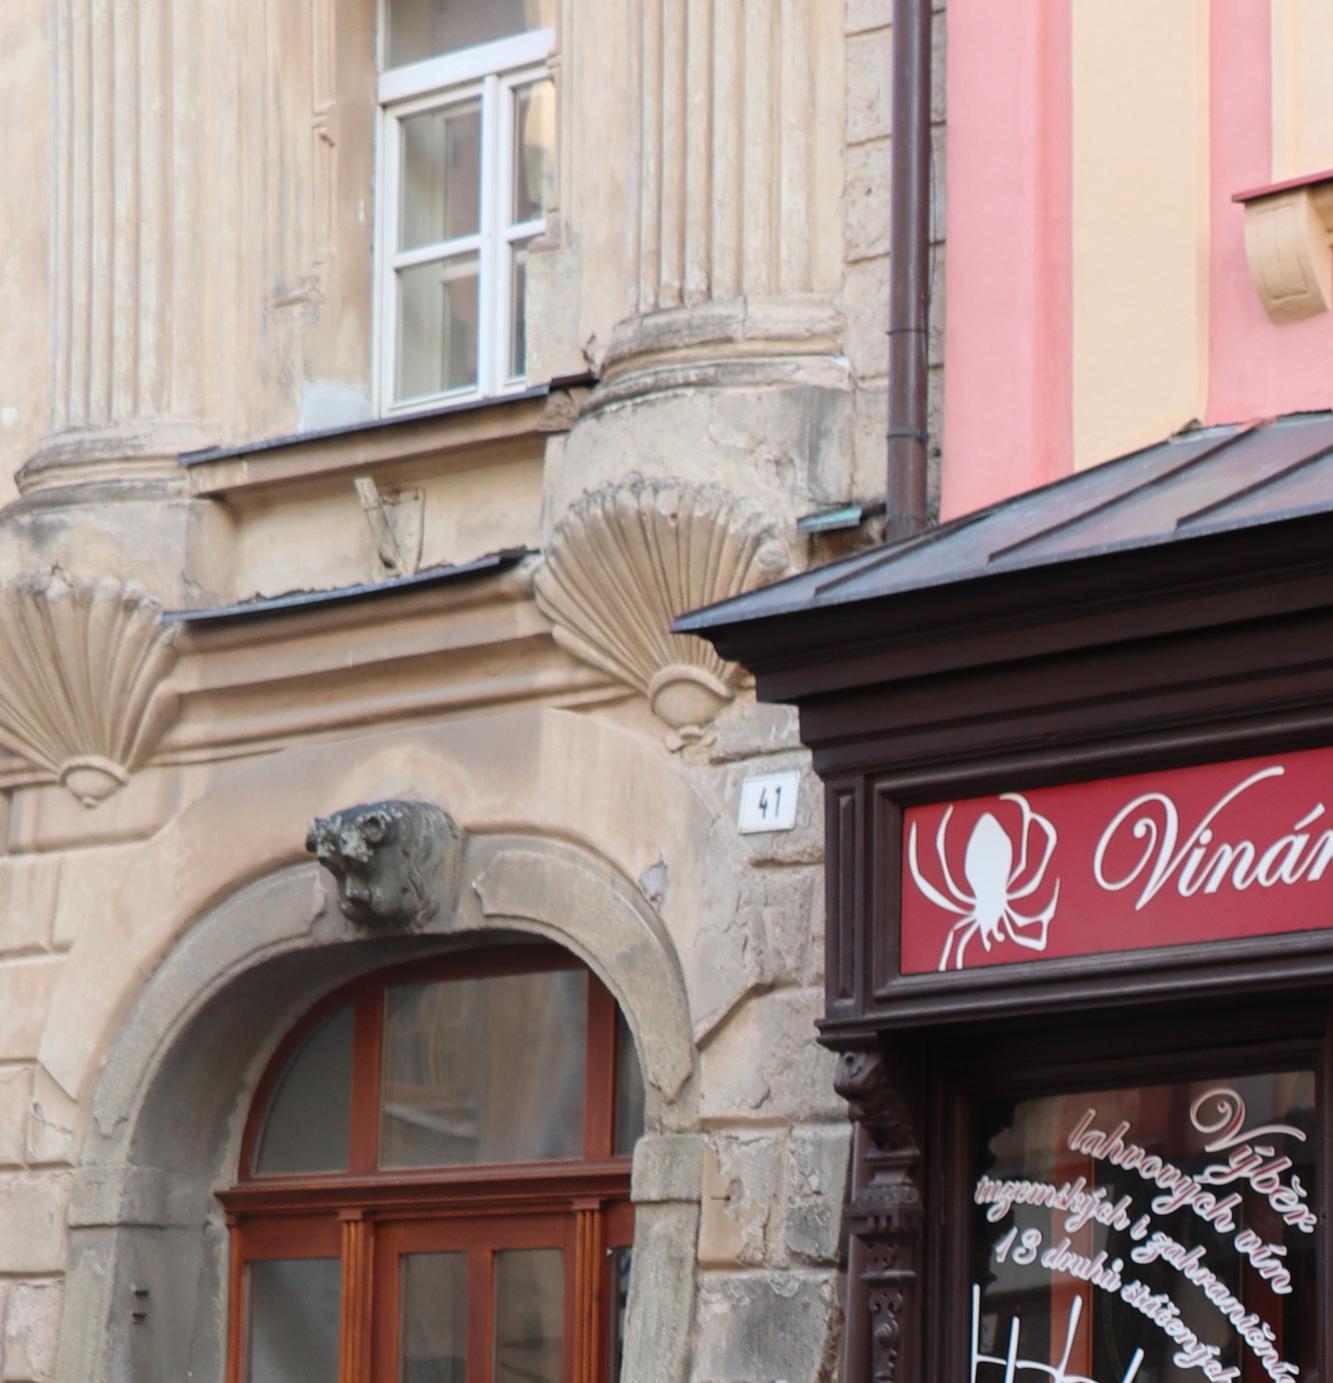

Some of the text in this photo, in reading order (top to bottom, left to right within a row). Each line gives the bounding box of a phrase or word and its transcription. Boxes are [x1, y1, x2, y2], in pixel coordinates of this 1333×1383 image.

[758, 786, 782, 819] 41
[1189, 1087, 1318, 1233] Výběr
[974, 1175, 1133, 1233] tuzemských
[1131, 1213, 1151, 1242] i
[1067, 1107, 1294, 1295] lahvových vín
[994, 1226, 1043, 1265] 13
[1041, 1236, 1123, 1292] druhů
